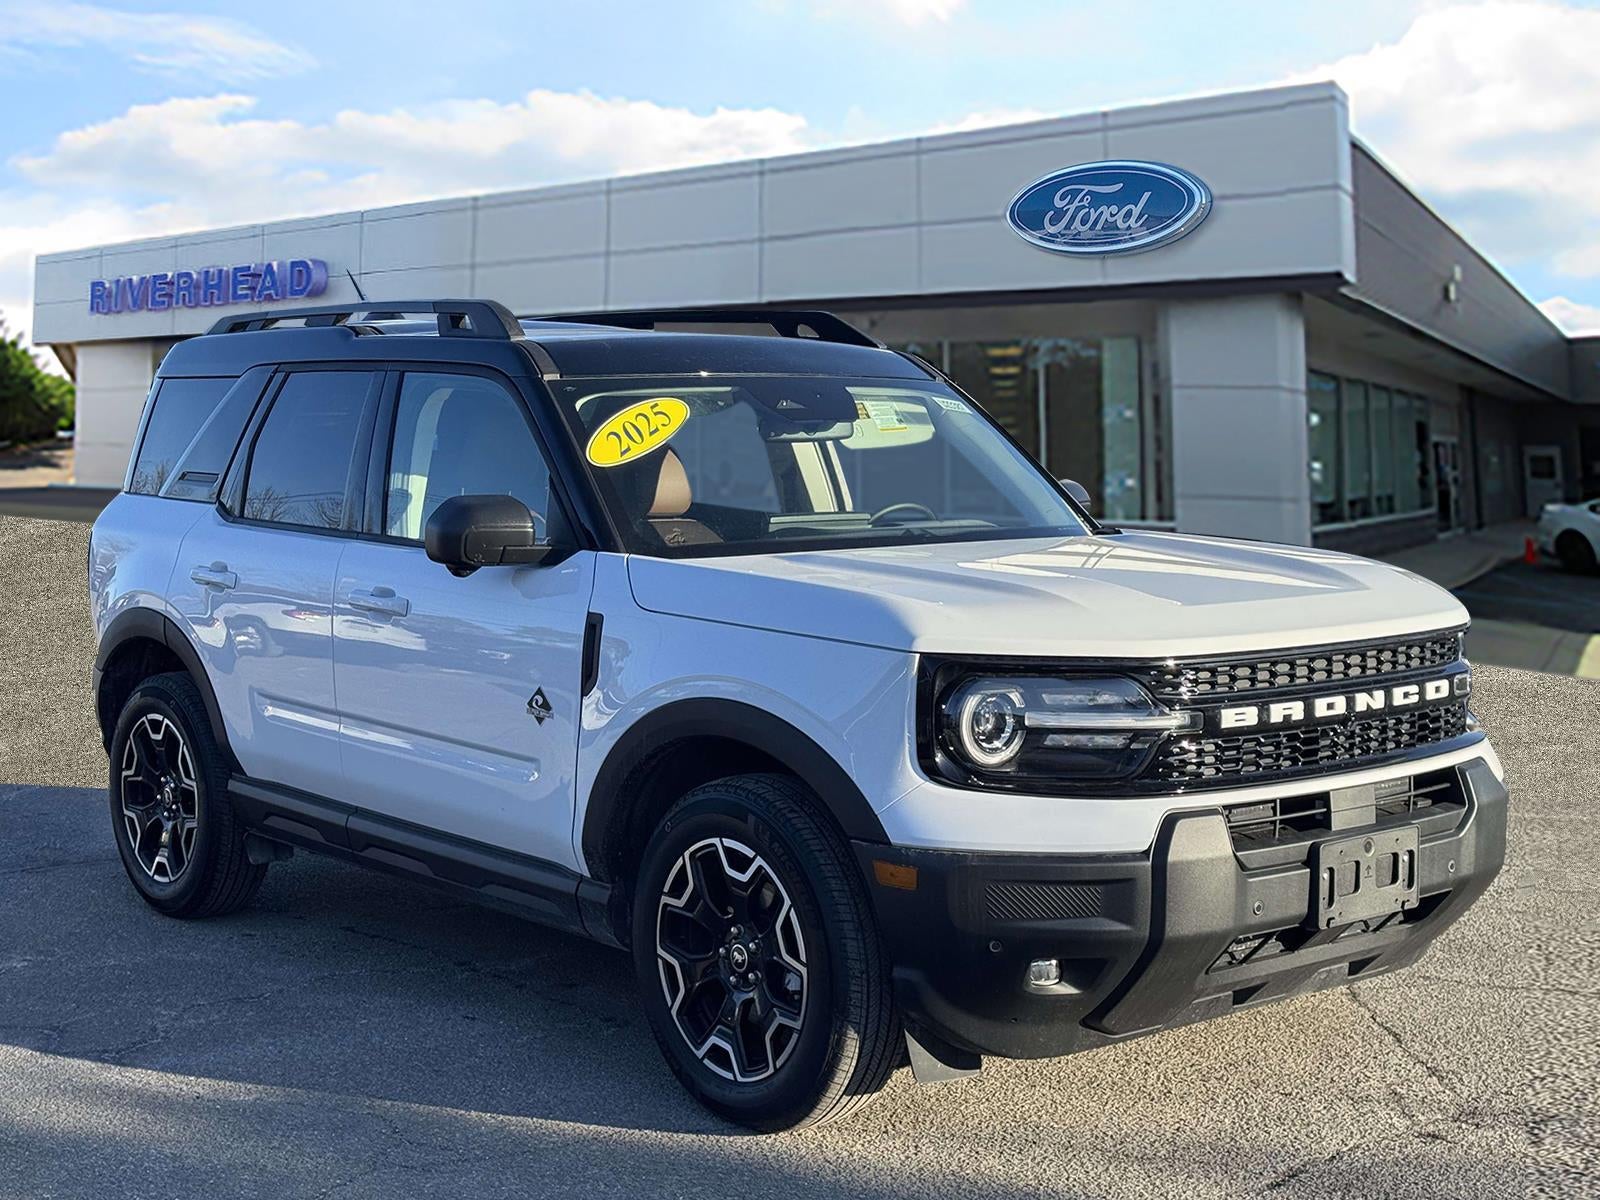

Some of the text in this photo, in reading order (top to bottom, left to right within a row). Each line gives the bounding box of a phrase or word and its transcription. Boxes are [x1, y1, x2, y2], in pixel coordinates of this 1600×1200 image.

[1043, 182, 1152, 234] Ford
[89, 259, 320, 314] RIVERHEAD
[606, 402, 672, 458] 2025
[1220, 678, 1450, 729] BRONCO
